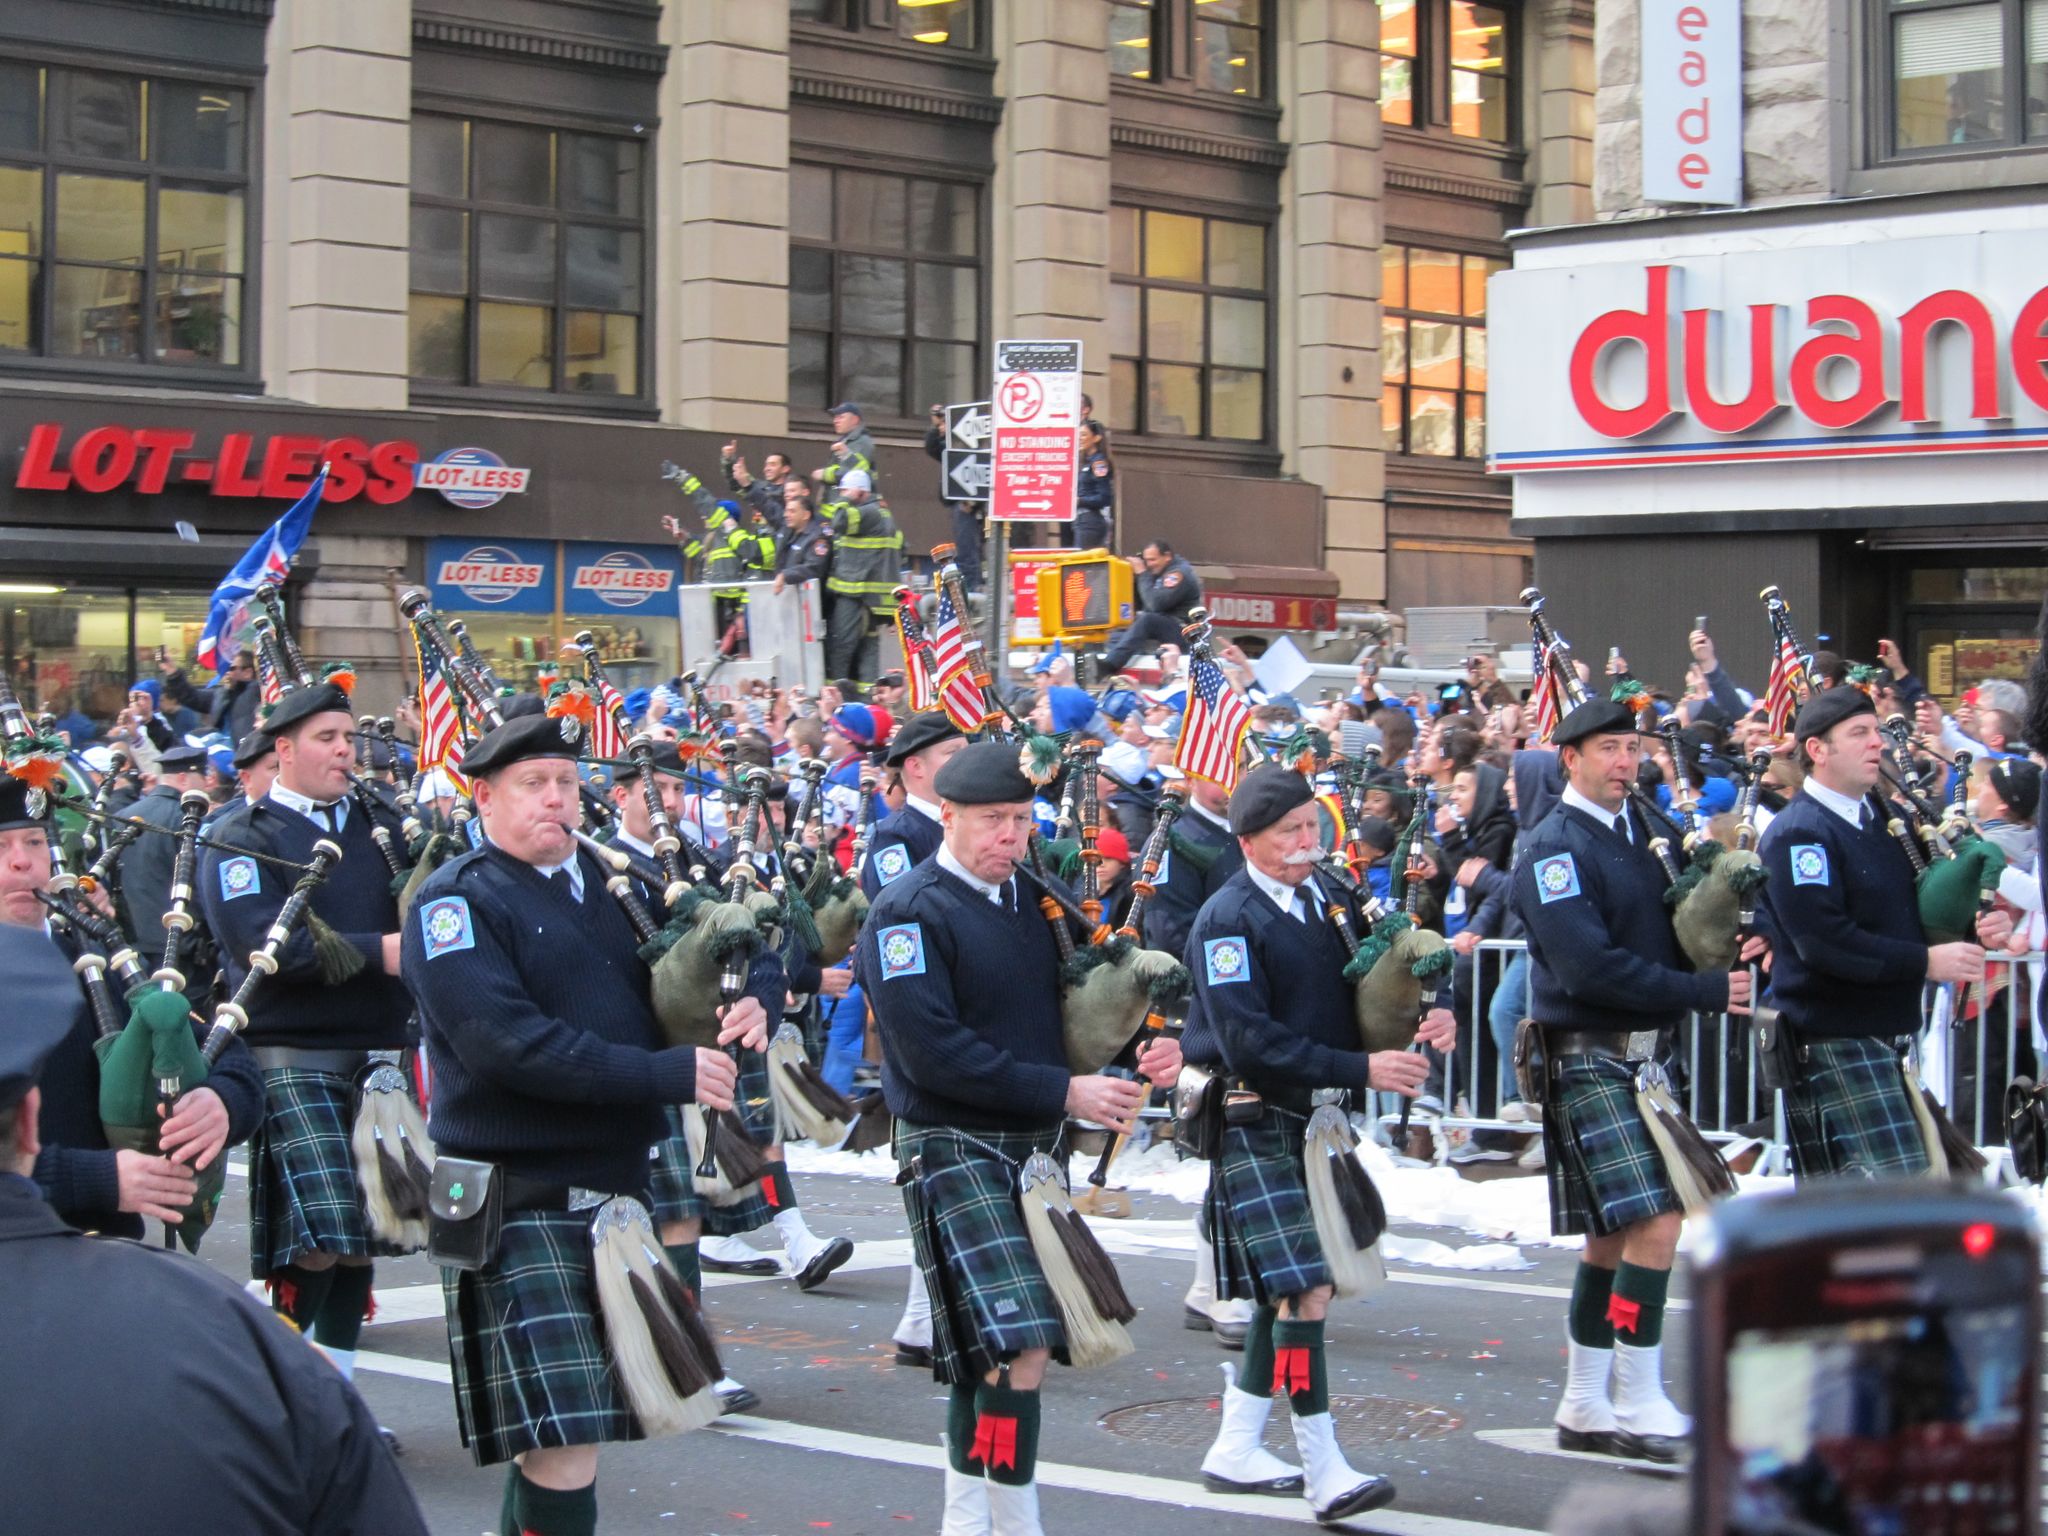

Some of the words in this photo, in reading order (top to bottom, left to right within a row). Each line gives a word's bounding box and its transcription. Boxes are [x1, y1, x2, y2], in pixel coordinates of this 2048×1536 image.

[1000, 436, 1017, 449] NO
[1018, 436, 1071, 449] STANDING
[15, 423, 420, 505] LOT-LESS
[422, 467, 524, 489] LOT-LESS
[443, 565, 540, 584] LOT-LESS
[577, 570, 668, 589] LOT-LESS
